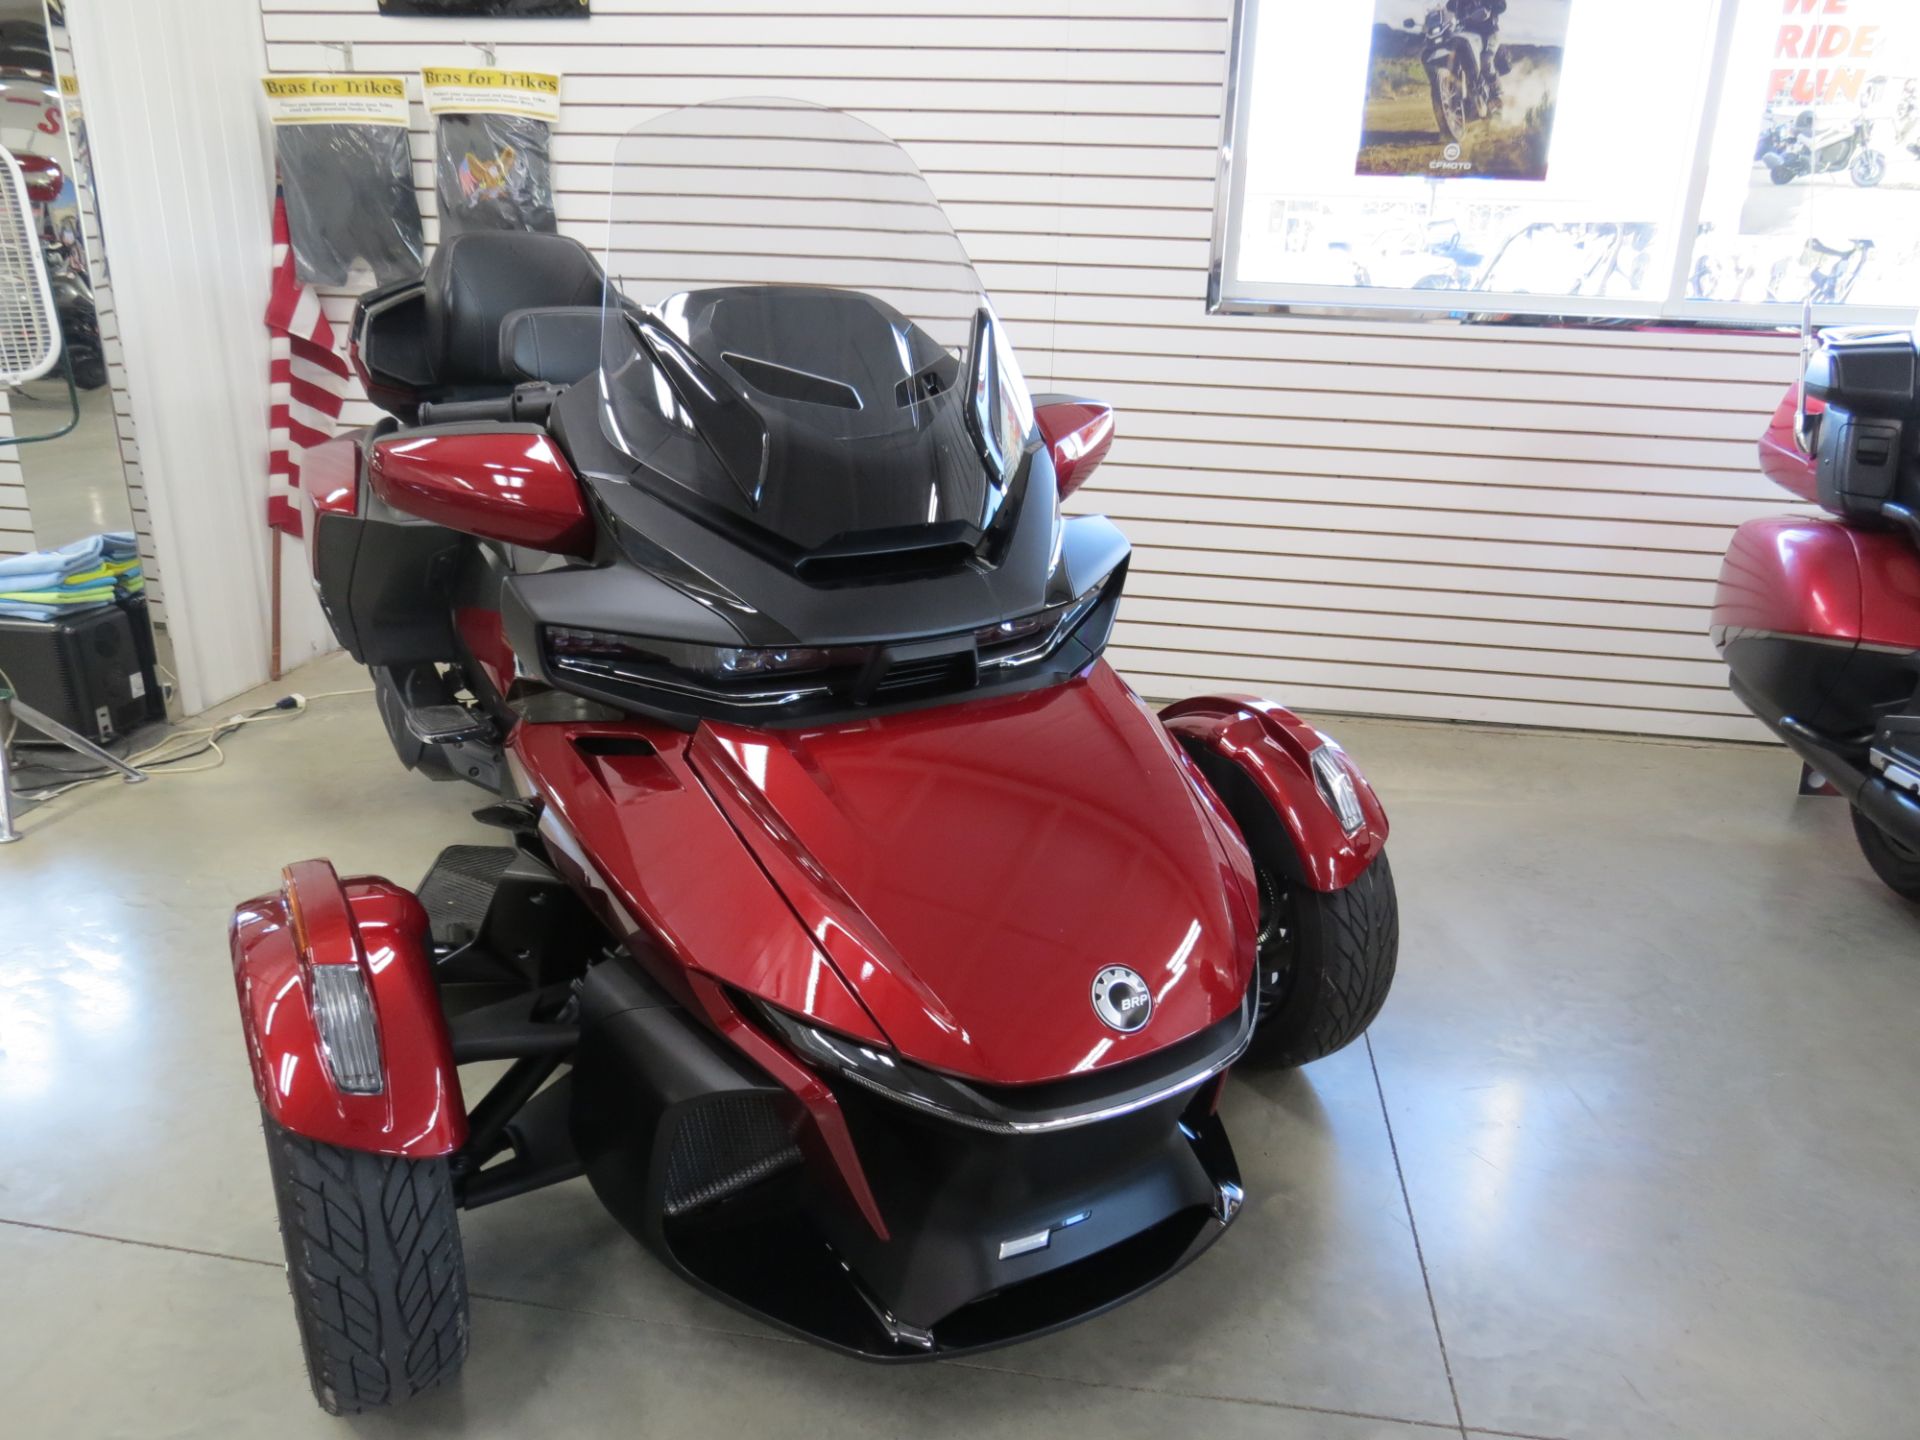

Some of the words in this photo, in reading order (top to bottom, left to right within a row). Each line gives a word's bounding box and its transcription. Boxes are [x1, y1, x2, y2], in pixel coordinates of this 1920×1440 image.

[1774, 25, 1880, 58] RIDE
[265, 80, 306, 95] Bras
[312, 79, 338, 94] for
[346, 80, 403, 96] Trikes
[424, 71, 461, 85] Bras
[468, 71, 493, 85] for
[500, 73, 557, 91] Trikes
[1767, 69, 1867, 103] FUN
[1121, 994, 1148, 1011] BRP
